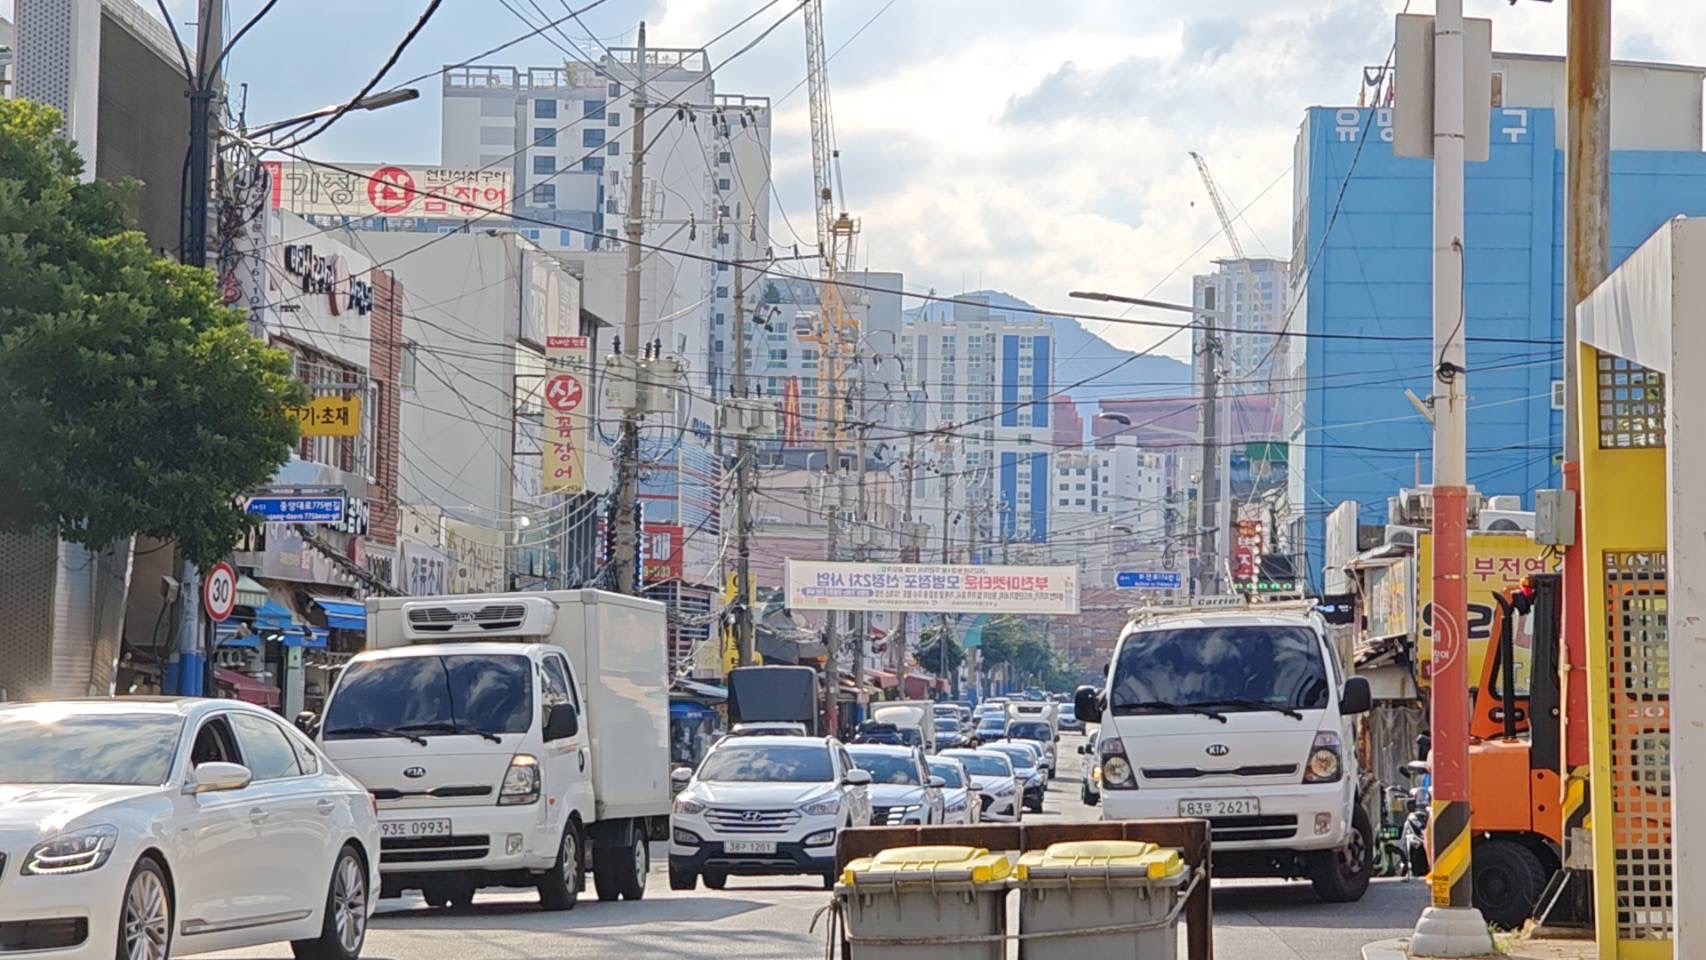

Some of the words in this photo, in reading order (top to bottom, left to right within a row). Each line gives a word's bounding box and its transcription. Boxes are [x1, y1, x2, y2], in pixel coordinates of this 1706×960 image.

[426, 168, 506, 184] 연탄석쇠구이
[286, 171, 360, 205] 기장
[549, 354, 585, 372] 기장
[548, 378, 580, 408] 산
[279, 500, 341, 512] 중앙대로775번길
[1472, 556, 1546, 583] 부전역
[211, 577, 229, 604] 30
[1197, 597, 1242, 607] Carrier
[1207, 745, 1227, 755] KIA
[405, 767, 425, 777] KIA
[1218, 800, 1250, 814] 2621
[411, 821, 444, 835] 0993
